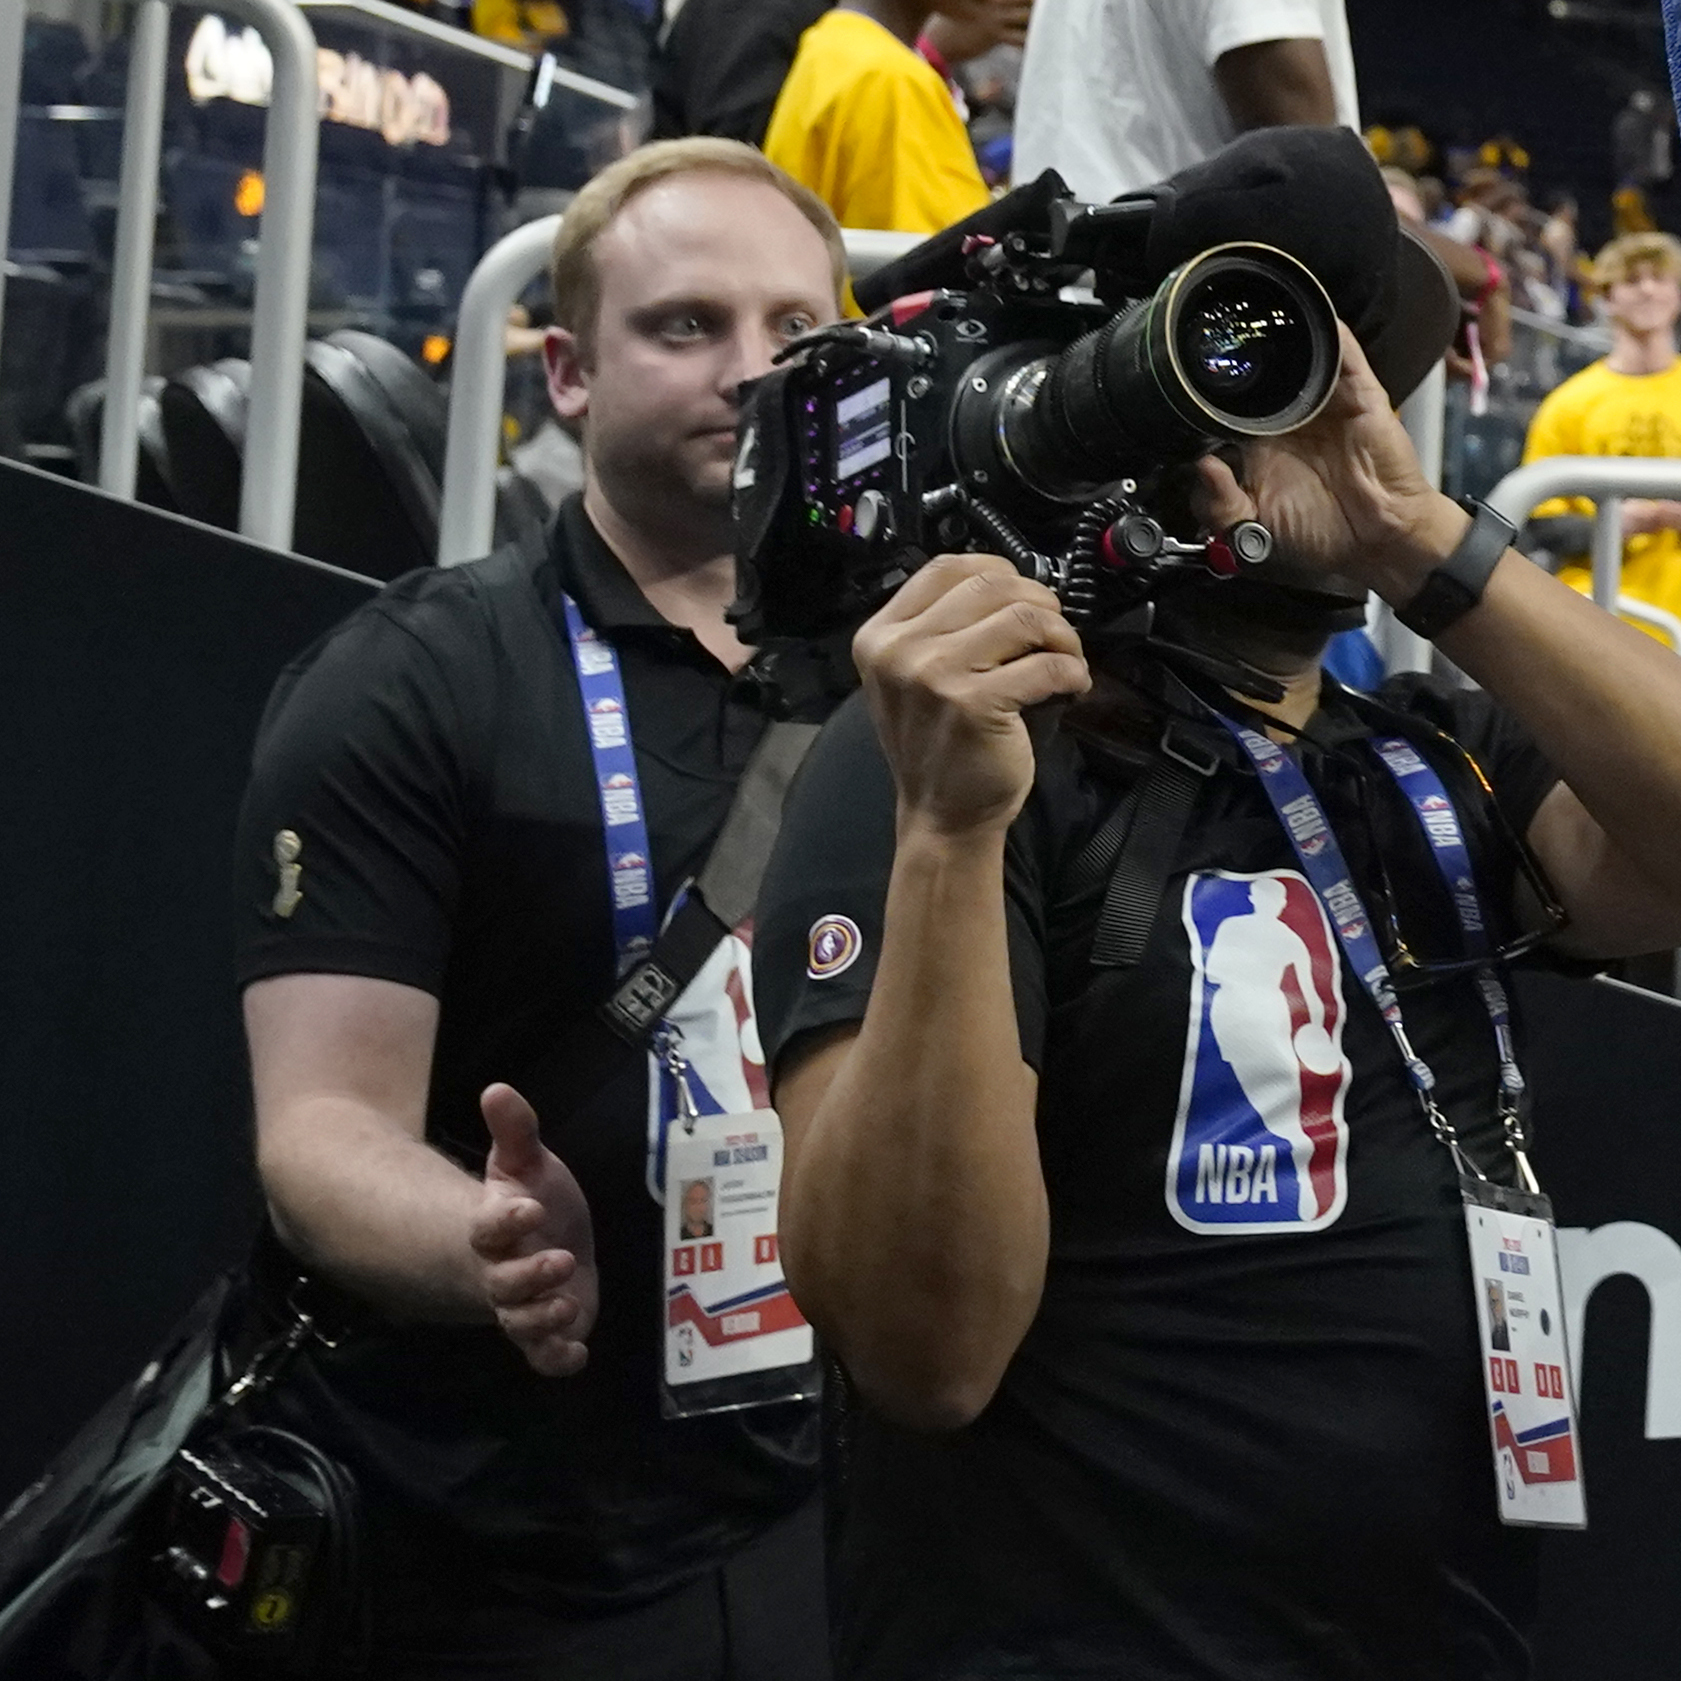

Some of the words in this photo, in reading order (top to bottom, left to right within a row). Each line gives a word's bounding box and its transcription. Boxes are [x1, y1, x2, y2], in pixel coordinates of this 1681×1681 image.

[588, 711, 627, 749] NBA
[602, 787, 641, 827] NBA
[1280, 793, 1328, 843] NBA
[1420, 809, 1464, 848] NBA
[613, 868, 650, 910] NBA
[1322, 878, 1365, 927] NBA
[1454, 892, 1485, 932] NBA
[1194, 1143, 1279, 1205] NBA
